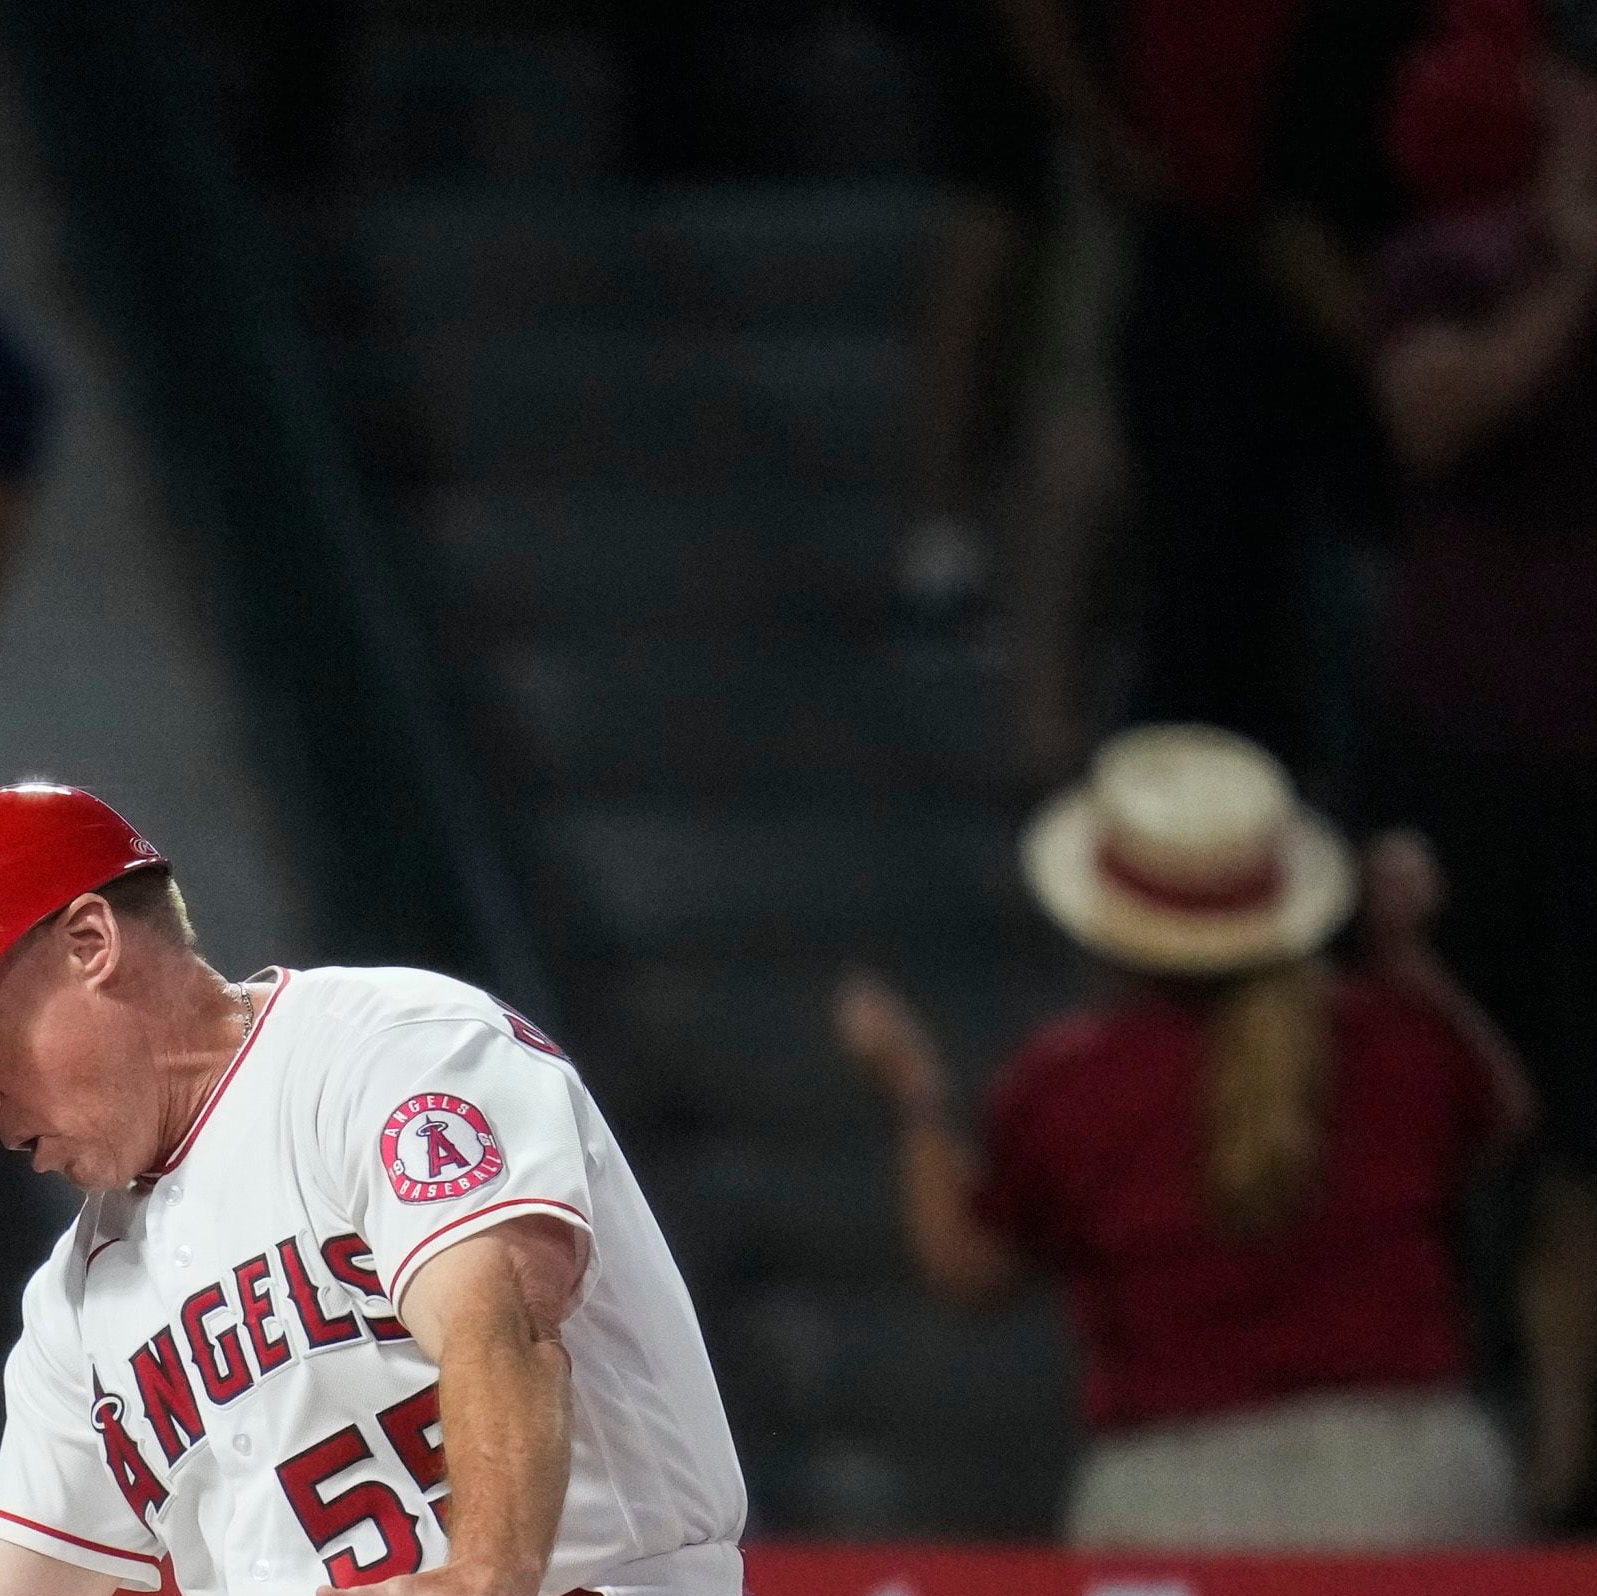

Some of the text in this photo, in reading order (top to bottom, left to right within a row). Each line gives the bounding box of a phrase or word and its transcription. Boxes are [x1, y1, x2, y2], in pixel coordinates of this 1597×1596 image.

[384, 1095, 470, 1138] ANGELS
[399, 1155, 503, 1200] BASEBALL
[92, 1232, 414, 1537] ANGELS
